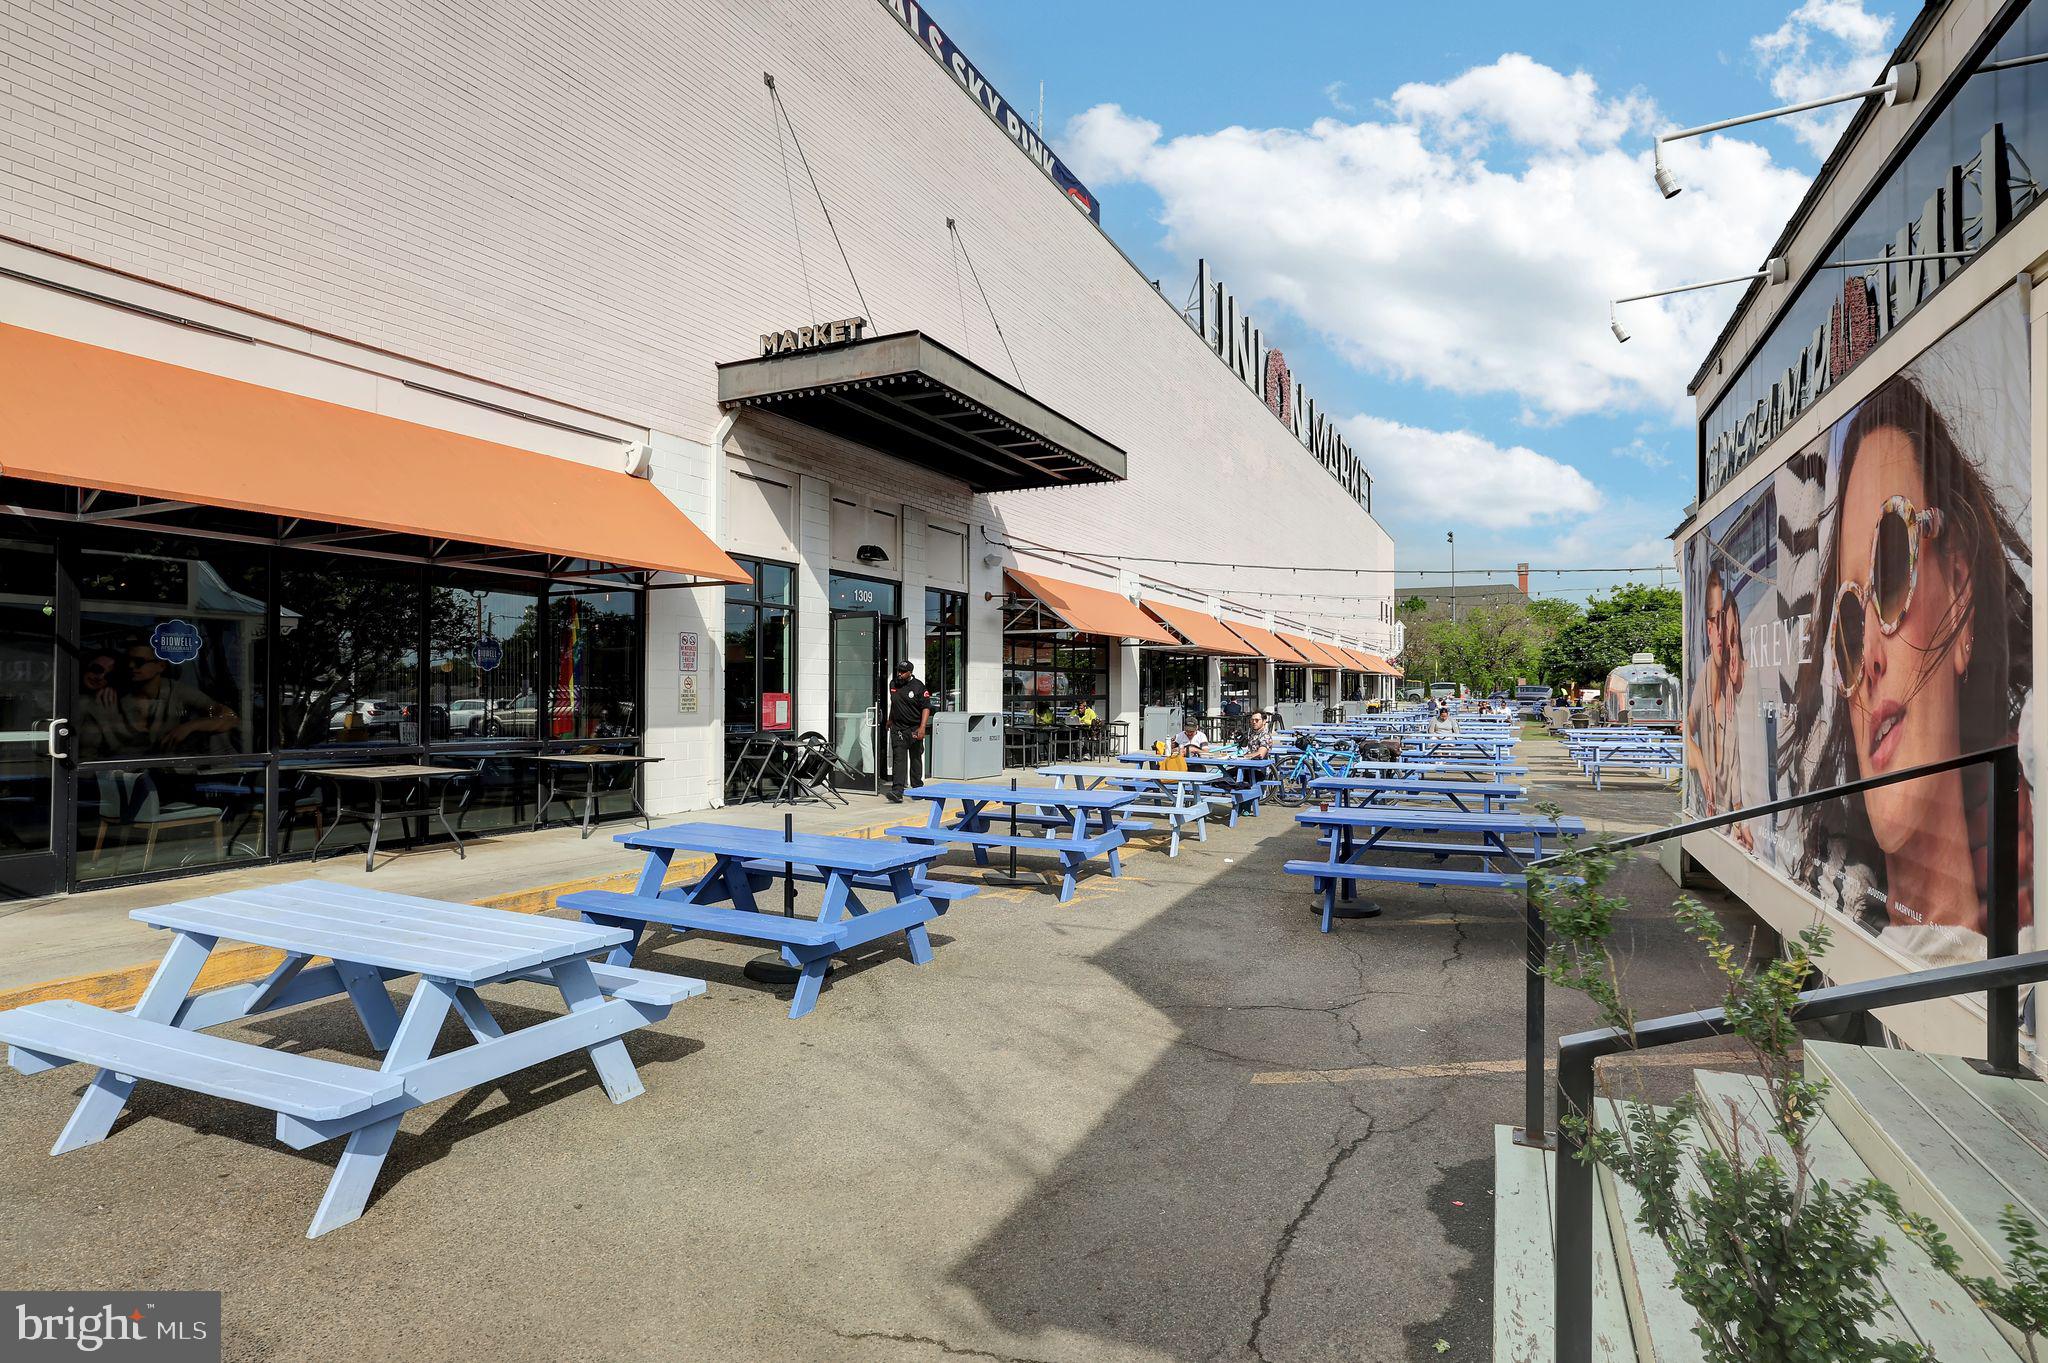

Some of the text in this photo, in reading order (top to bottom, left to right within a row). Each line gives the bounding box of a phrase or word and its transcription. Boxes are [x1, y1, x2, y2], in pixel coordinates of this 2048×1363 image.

[951, 52, 1000, 117] SKY
[760, 316, 867, 356] MARKET
[1199, 259, 1374, 514] UNION MARKET
[854, 589, 873, 603] 1309
[161, 636, 193, 647] BIDWELL
[1894, 901, 1923, 923] NASHVILLE
